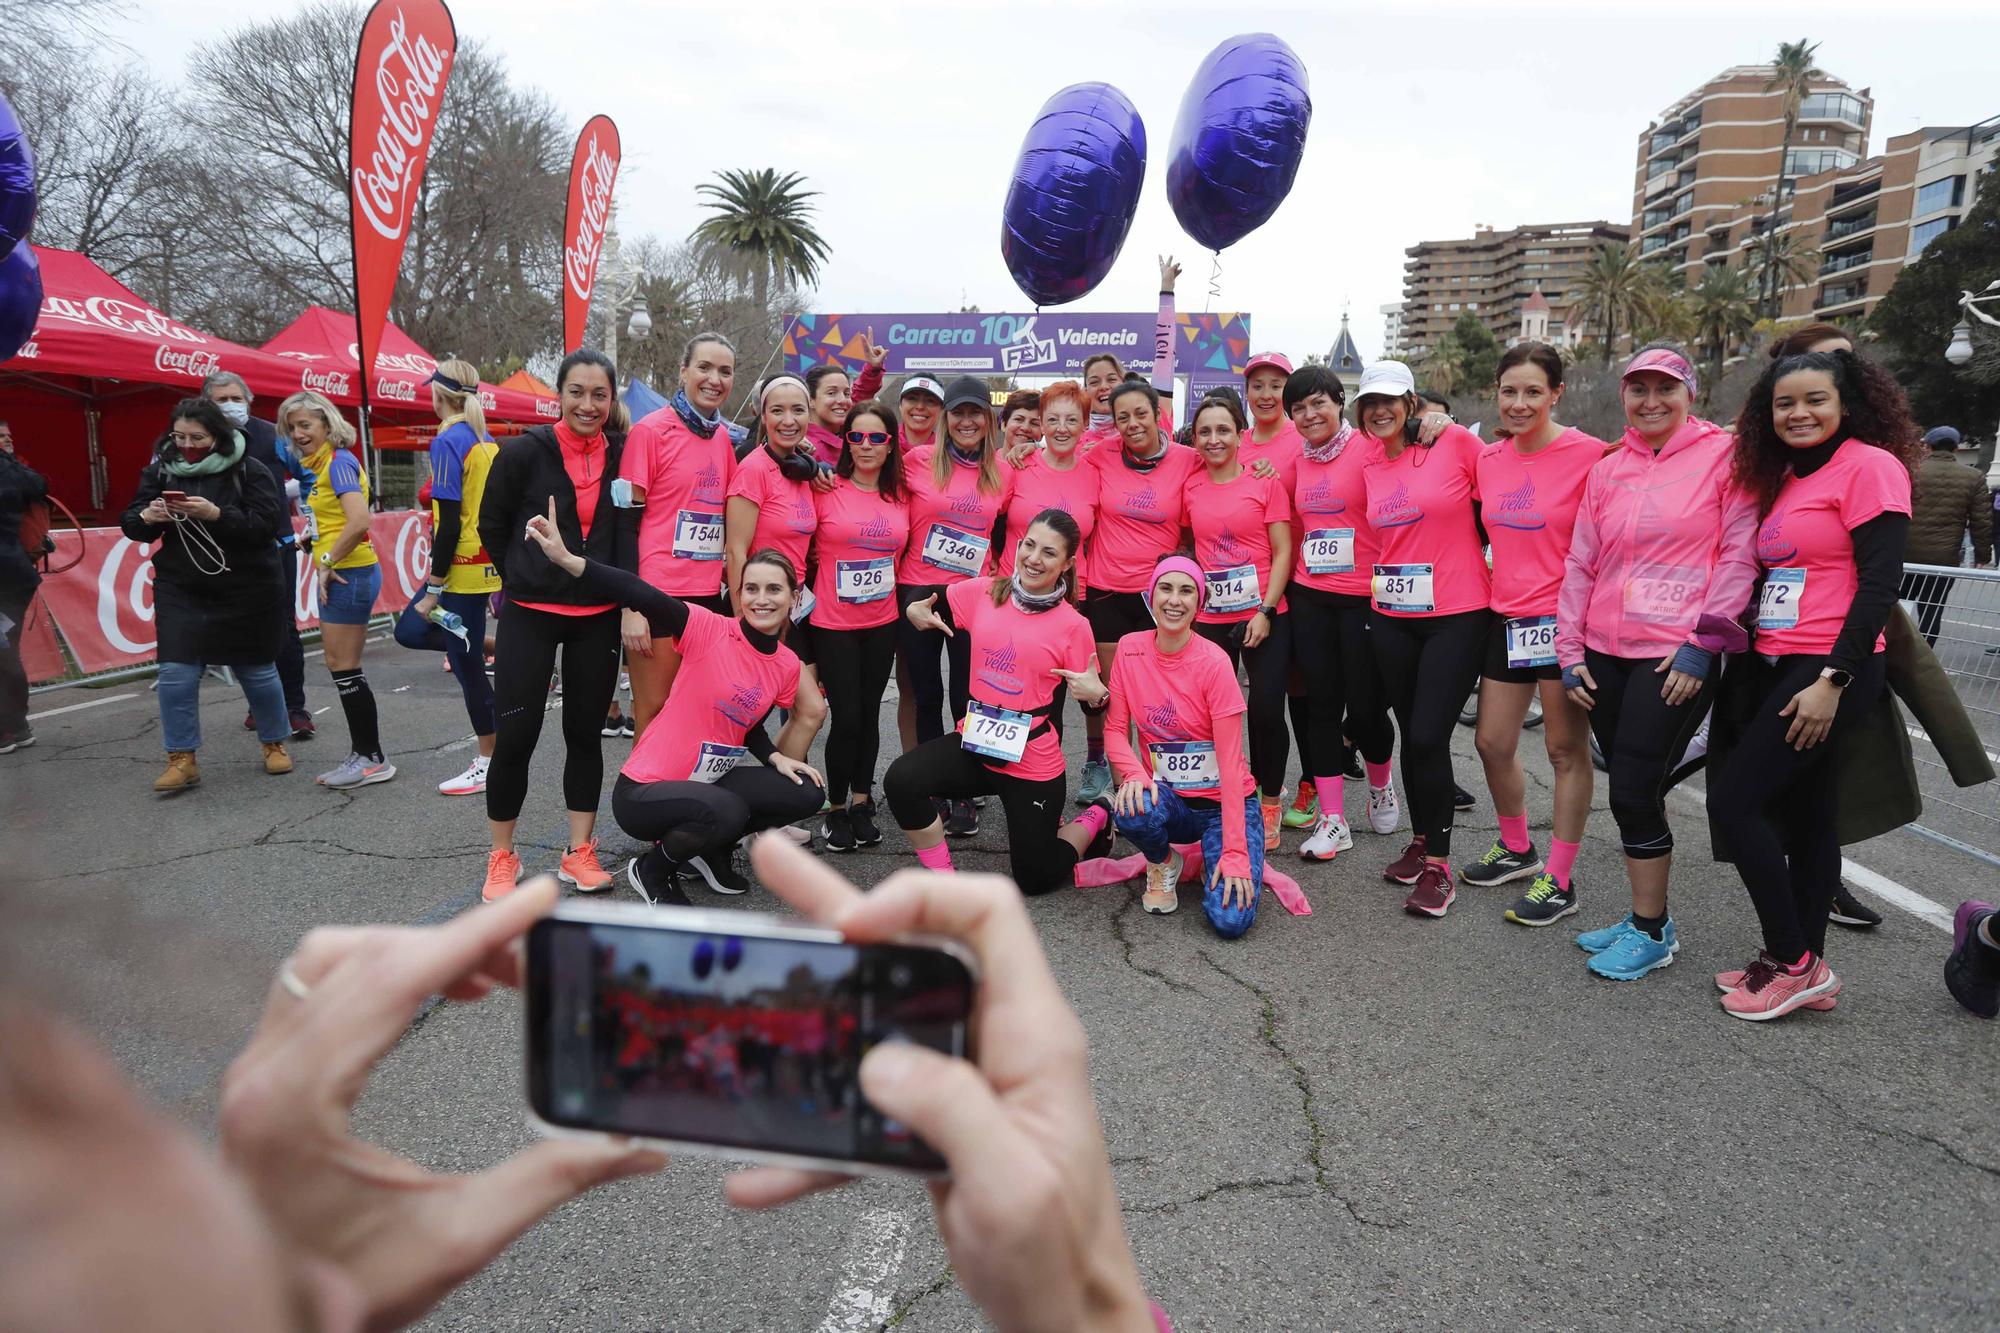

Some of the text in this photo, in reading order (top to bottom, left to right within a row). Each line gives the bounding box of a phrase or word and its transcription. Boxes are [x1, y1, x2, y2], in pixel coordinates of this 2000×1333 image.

[354, 6, 443, 240] Coca-Cola
[566, 130, 615, 300] Coca-Cola
[889, 315, 1139, 347] Carrera 10K Valencia
[301, 367, 349, 396] Coca-Cola
[377, 376, 416, 401] Coca-Cola
[689, 525, 721, 541] 1544
[938, 538, 976, 560] 1346
[1310, 541, 1338, 555] 186
[853, 571, 882, 586] 926
[1386, 578, 1414, 593] 851
[1215, 580, 1243, 596] 914
[1649, 605, 1682, 613] PATRICI
[976, 718, 1018, 740] 1705
[706, 757, 735, 773] 1869
[1168, 755, 1201, 771] 882
